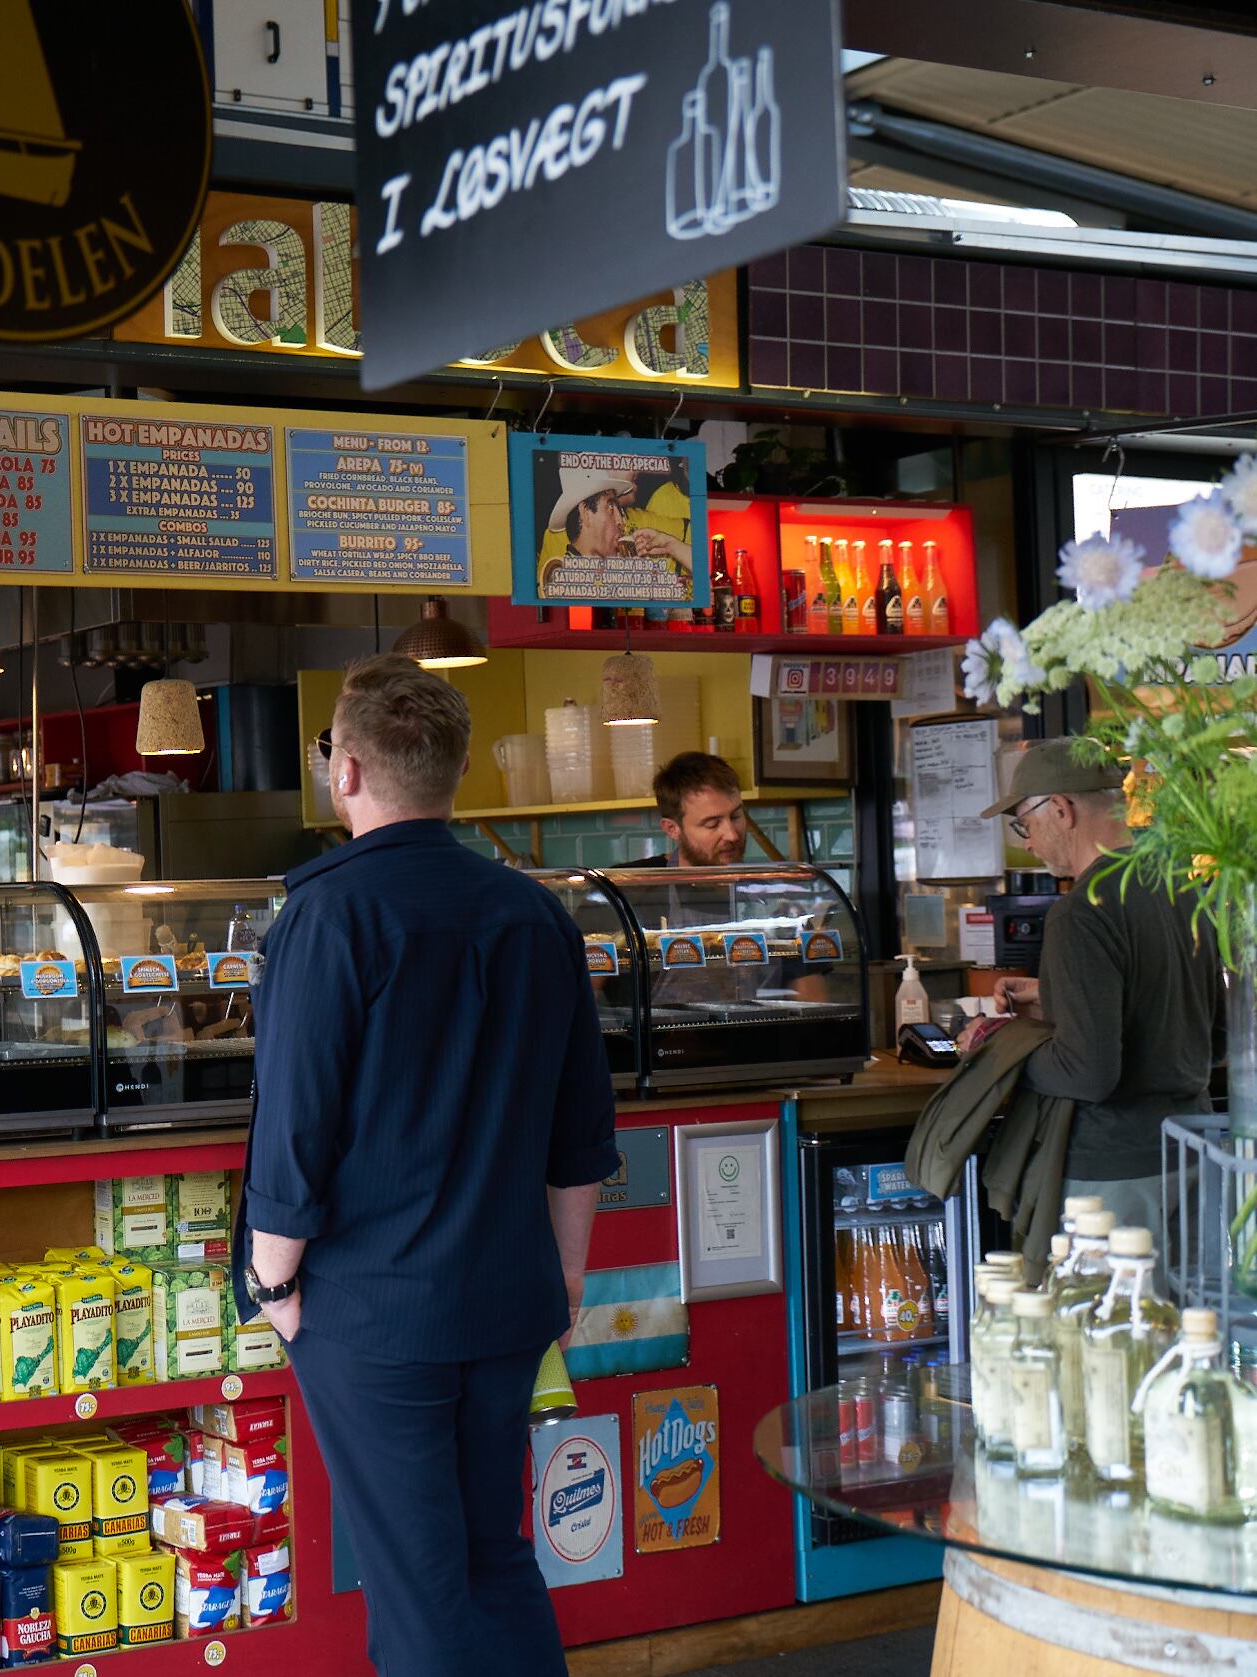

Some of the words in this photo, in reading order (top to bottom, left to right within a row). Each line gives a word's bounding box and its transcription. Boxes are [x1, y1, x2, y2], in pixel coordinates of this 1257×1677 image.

[375, 173, 410, 255] I
[86, 419, 134, 446] HOT
[138, 424, 269, 453] EMPANADAS
[377, 437, 412, 453] FROM
[162, 450, 200, 462] PRICES
[561, 454, 578, 467] END
[582, 454, 594, 468] OF
[595, 455, 612, 469] THE
[613, 456, 632, 470] DAY
[633, 457, 669, 471] SPECIAL
[41, 459, 56, 474] 75
[130, 462, 208, 478] EMPANADA
[336, 456, 382, 473] AREPA
[17, 476, 34, 490] 85
[133, 476, 217, 492] EMPANADAS
[236, 482, 254, 494] 90
[412, 486, 453, 494] CORIANDER
[25, 495, 41, 509] 85
[132, 491, 217, 506] EMPANADAS
[126, 506, 156, 516] EXTRA
[159, 508, 217, 519] EMPANADAS
[378, 499, 430, 514] BURGER
[3, 513, 18, 527] 85
[374, 513, 401, 521] PULLED
[158, 520, 208, 533] COMBOS
[340, 522, 380, 530] CUCUMBER
[20, 532, 37, 546] 95
[108, 533, 167, 544] EMPANADAS
[176, 536, 206, 546] SMALL
[208, 537, 238, 546] SALAD
[339, 535, 396, 550] BURRITO
[18, 550, 35, 565] 95
[108, 547, 168, 557] EMPANADAS
[178, 548, 219, 558] ALFAJOR
[338, 551, 371, 559] TORTILLA
[108, 559, 168, 570] EMPANADAS
[178, 561, 249, 572] BEER/JARRITOS
[565, 558, 599, 569] MONDAY
[607, 559, 635, 570] FRIDAY
[555, 572, 594, 582] SATURDAY
[603, 573, 632, 583] SUNDAY
[549, 585, 596, 596] EMPANADAS
[617, 586, 650, 597] QUILMES
[652, 587, 671, 597] BEER
[11, 1312, 54, 1333] PLAYADITO
[71, 1305, 113, 1325] PLAYADITO
[639, 1418, 671, 1488] Hot
[671, 1417, 715, 1461] Dogs
[553, 1484, 601, 1514] Quilmes
[104, 1516, 146, 1535] CANARIAS
[571, 1516, 591, 1532] Cristal
[643, 1522, 663, 1542] HOT
[675, 1514, 710, 1538] FRESH
[121, 1539, 135, 1547] 500g
[18, 1620, 51, 1635] NOBLEZA
[130, 1624, 173, 1642] CANARIAS
[20, 1630, 51, 1644] GAUCHA
[73, 1632, 116, 1652] CANARIAS
